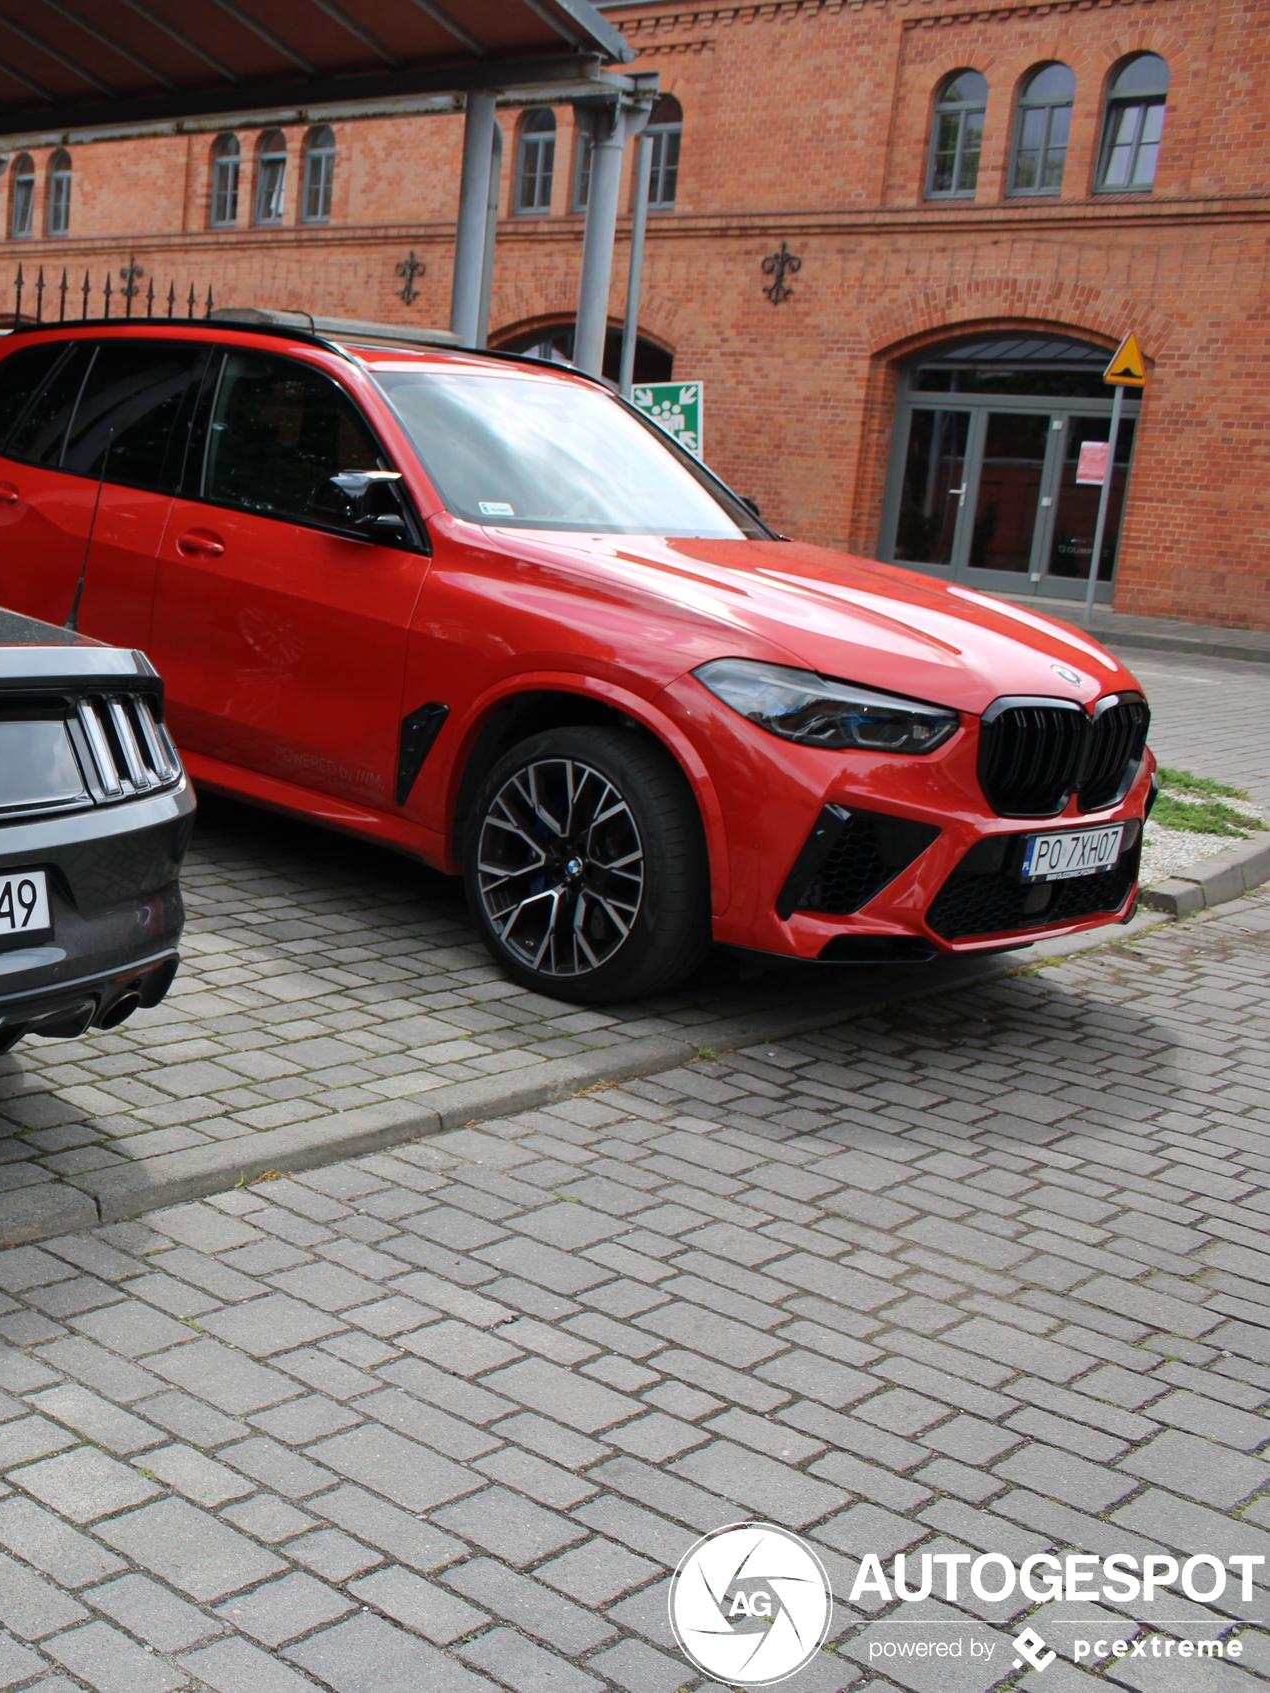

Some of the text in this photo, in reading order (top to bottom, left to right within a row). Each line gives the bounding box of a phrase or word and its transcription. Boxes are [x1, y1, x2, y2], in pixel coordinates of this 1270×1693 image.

[275, 744, 336, 775] POWERED
[339, 764, 353, 784] by
[1022, 862, 1030, 871] PL
[1034, 830, 1119, 872] PO 7XH07
